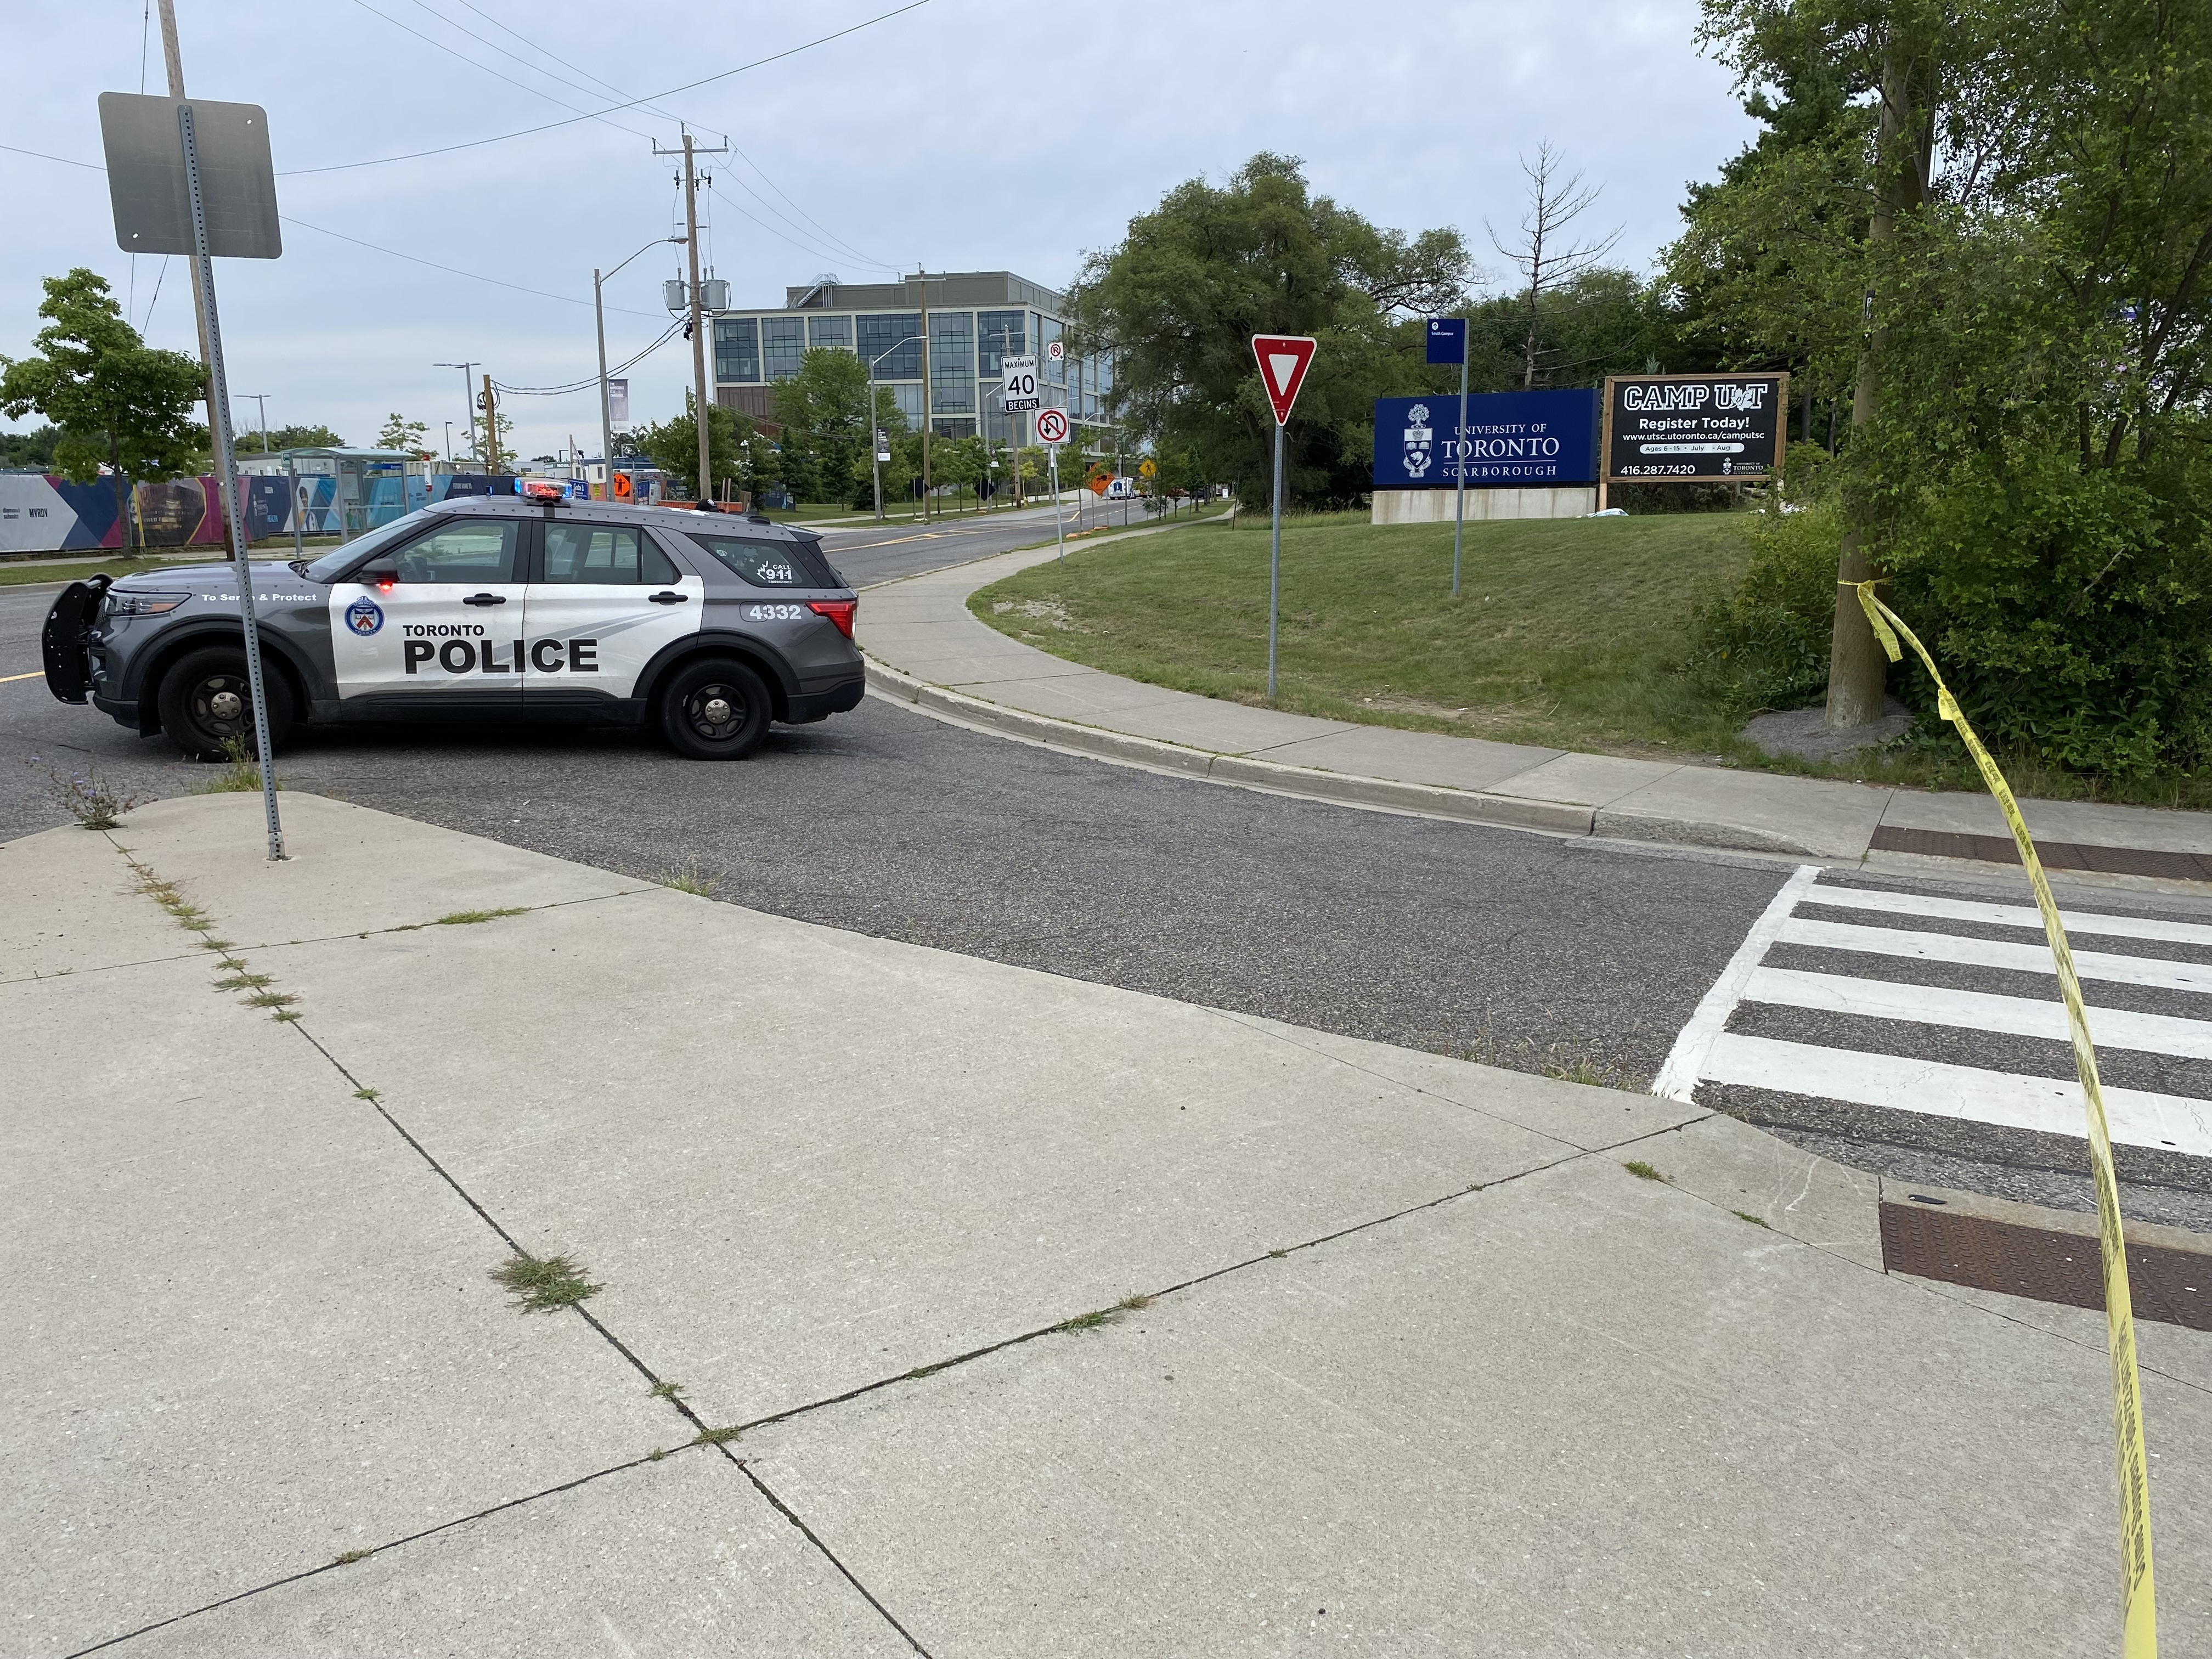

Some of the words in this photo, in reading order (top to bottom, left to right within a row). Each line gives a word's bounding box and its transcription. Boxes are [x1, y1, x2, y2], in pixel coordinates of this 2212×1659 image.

[1005, 360, 1034, 369] MAXIMUM
[1008, 375, 1034, 395] 40
[1624, 384, 1709, 411] CAMP
[1008, 399, 1037, 410] BEGINS
[1454, 424, 1526, 435] UNIVERSITY
[1531, 423, 1547, 432] OF
[1639, 417, 1698, 431] Register
[1701, 417, 1750, 430] Today!
[1622, 431, 1765, 440] www.utsc.utoronto.ca/camputsc
[1441, 437, 1560, 458] TORONTO
[1442, 466, 1556, 477] SCARBOROUGH
[1621, 465, 1695, 475] 416.287.7420
[749, 605, 802, 619] 4332
[402, 625, 484, 636] TORONTO
[403, 639, 599, 674] POLICE
